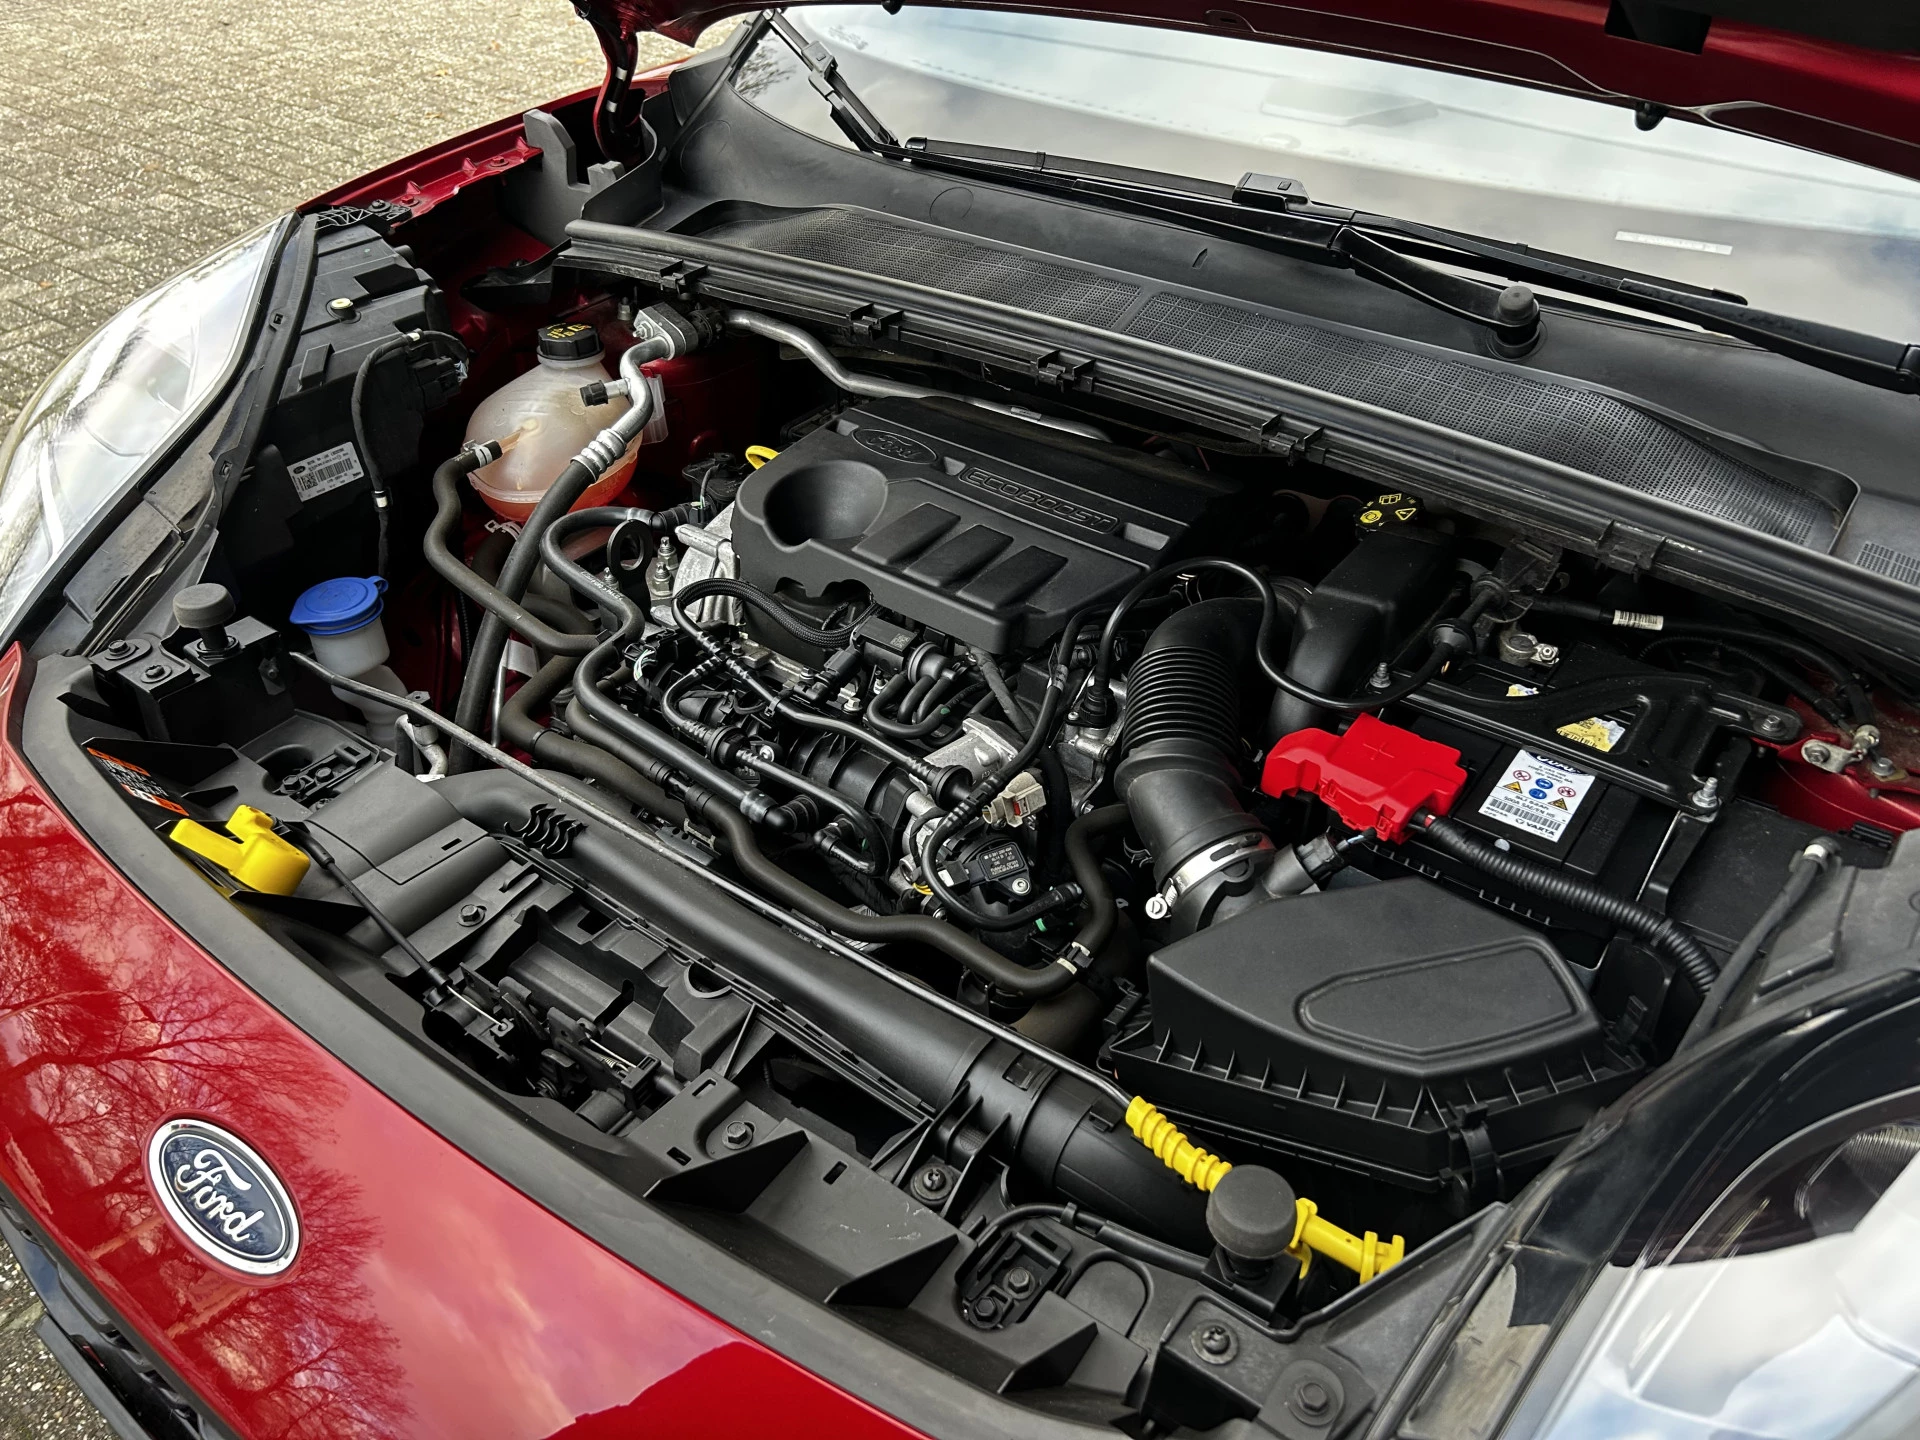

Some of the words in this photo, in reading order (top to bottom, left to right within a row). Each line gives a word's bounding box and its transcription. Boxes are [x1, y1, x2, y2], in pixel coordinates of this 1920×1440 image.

[866, 434, 922, 459] Ford
[966, 471, 1112, 526] ECOBOOST
[1526, 822, 1555, 836] VARTA
[174, 1149, 265, 1242] Ford
